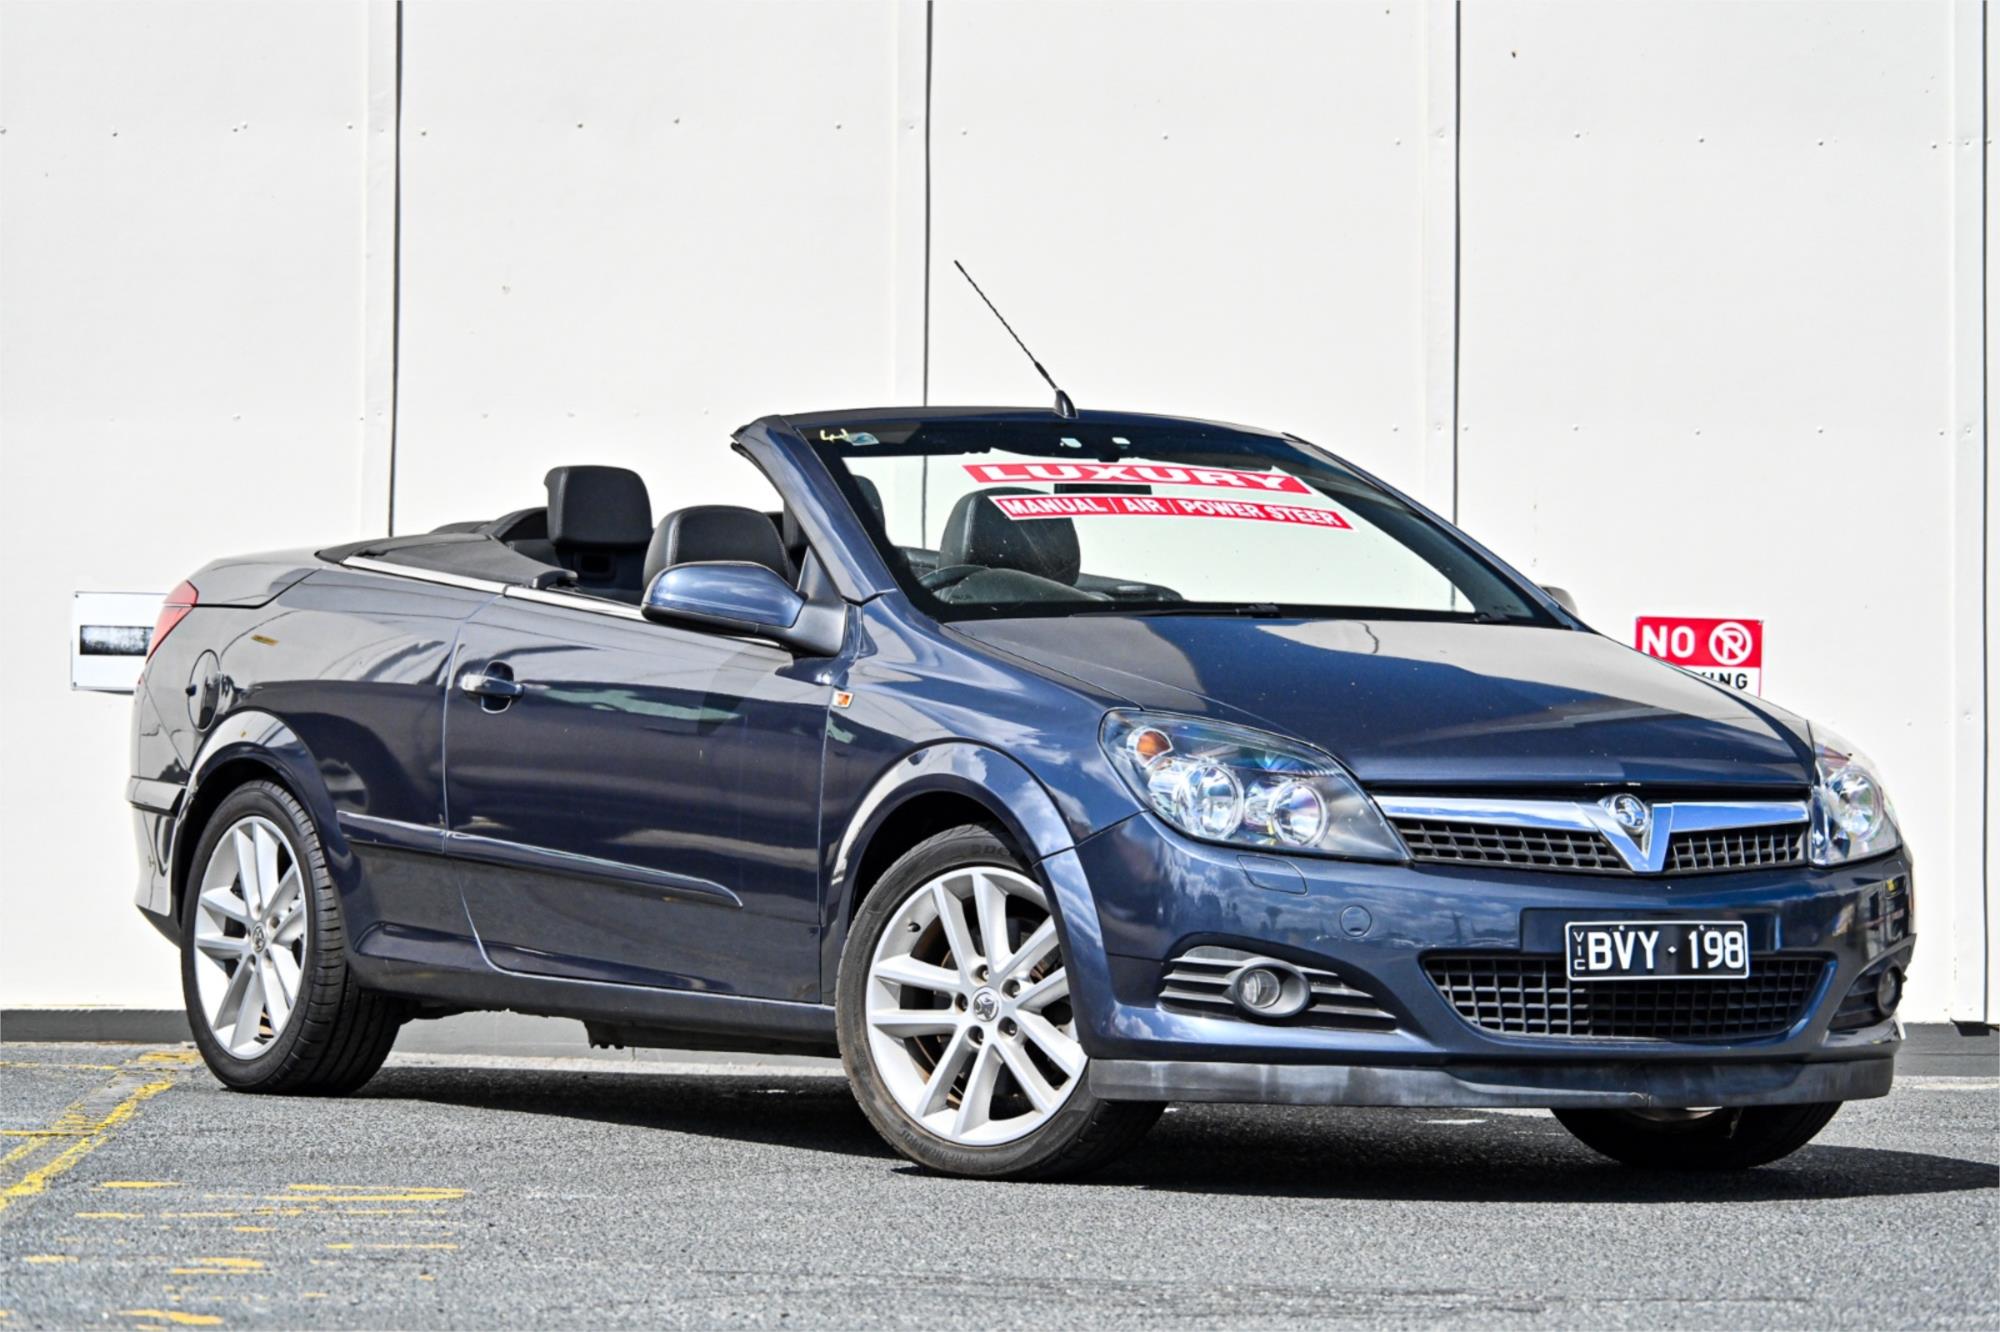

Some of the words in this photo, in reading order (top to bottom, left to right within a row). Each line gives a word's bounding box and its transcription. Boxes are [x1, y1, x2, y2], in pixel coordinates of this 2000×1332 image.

[979, 465, 1285, 490] LUXURY
[1001, 497, 1109, 515] MANUAL
[1122, 497, 1167, 514] AIR
[1177, 499, 1266, 519] POWER
[1264, 506, 1343, 526] STEER
[1641, 624, 1696, 658] NO
[1573, 931, 1586, 970] VIC
[1587, 930, 1660, 970] BVY
[1688, 930, 1745, 969] 198
